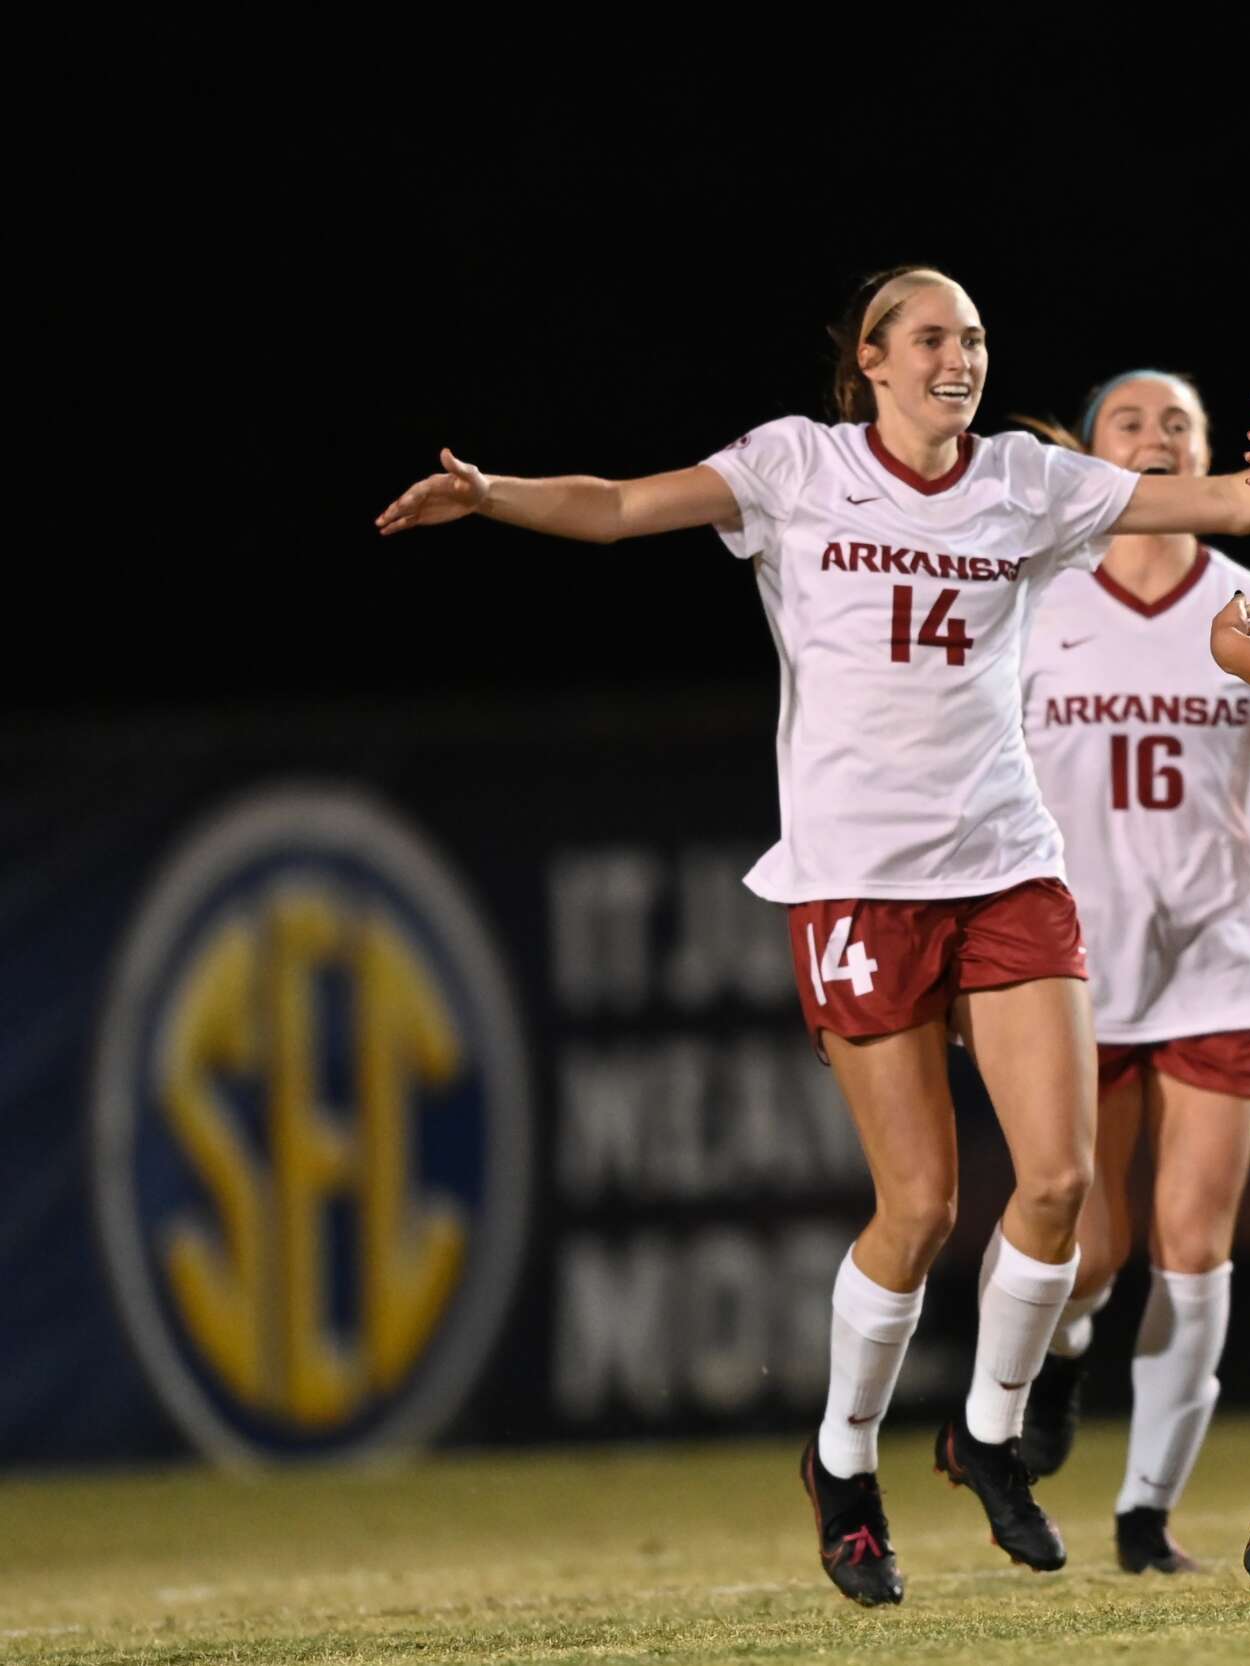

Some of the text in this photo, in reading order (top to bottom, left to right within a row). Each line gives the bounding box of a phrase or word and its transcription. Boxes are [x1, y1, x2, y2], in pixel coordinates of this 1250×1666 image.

[891, 584, 974, 666] 14
[1046, 695, 1249, 728] ARKANSAS
[1110, 734, 1184, 810] 16
[807, 916, 878, 1006] 14
[158, 882, 466, 1430] SEC
